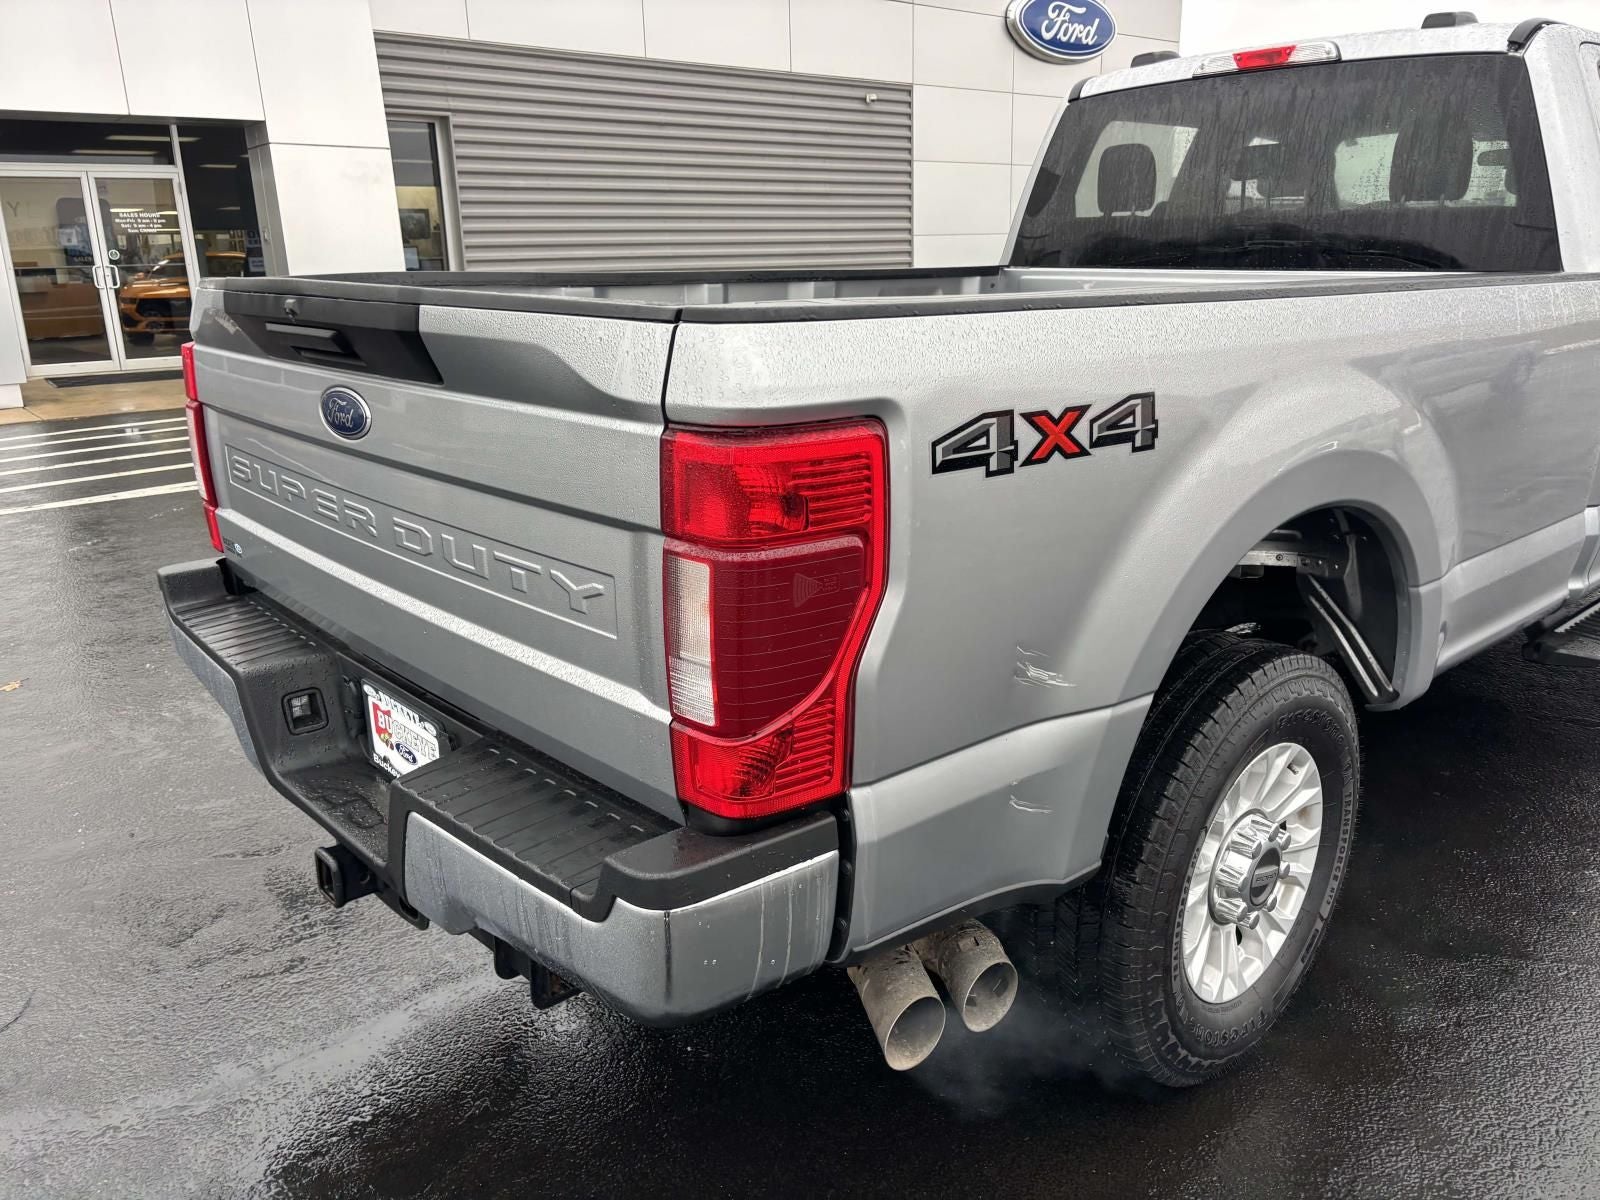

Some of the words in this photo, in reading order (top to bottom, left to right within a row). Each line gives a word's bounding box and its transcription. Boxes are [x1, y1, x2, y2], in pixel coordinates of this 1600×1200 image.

[1041, 1, 1100, 46] Ford
[327, 398, 354, 429] Ford
[229, 455, 377, 537] SUPER
[393, 517, 605, 614] DUTY
[376, 709, 438, 761] BUCKEYE
